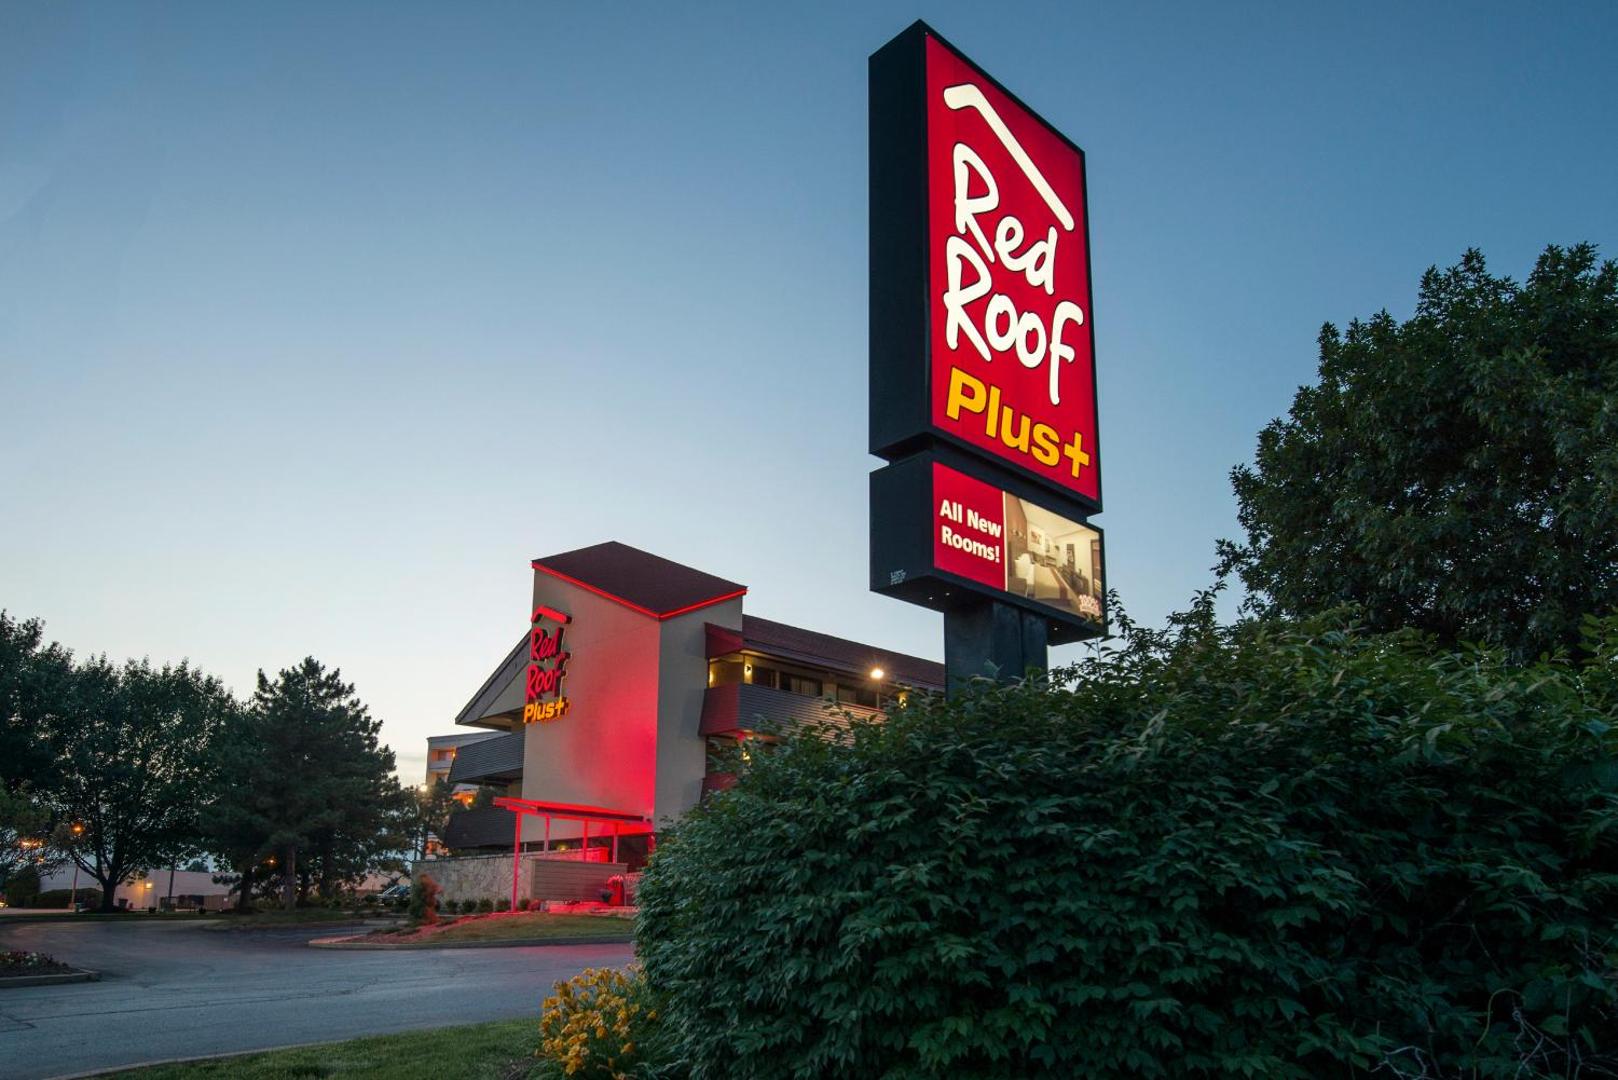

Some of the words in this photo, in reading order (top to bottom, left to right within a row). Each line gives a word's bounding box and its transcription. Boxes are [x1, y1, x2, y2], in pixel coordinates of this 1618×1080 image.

[953, 142, 1058, 295] Red
[943, 235, 1084, 406] Roof
[946, 366, 1090, 479] Plus+
[939, 499, 963, 525] All
[966, 508, 1002, 538] New
[941, 525, 1000, 563] Rooms!
[530, 626, 561, 661] Red
[525, 651, 567, 703] Roof
[523, 696, 565, 723] Plus+
